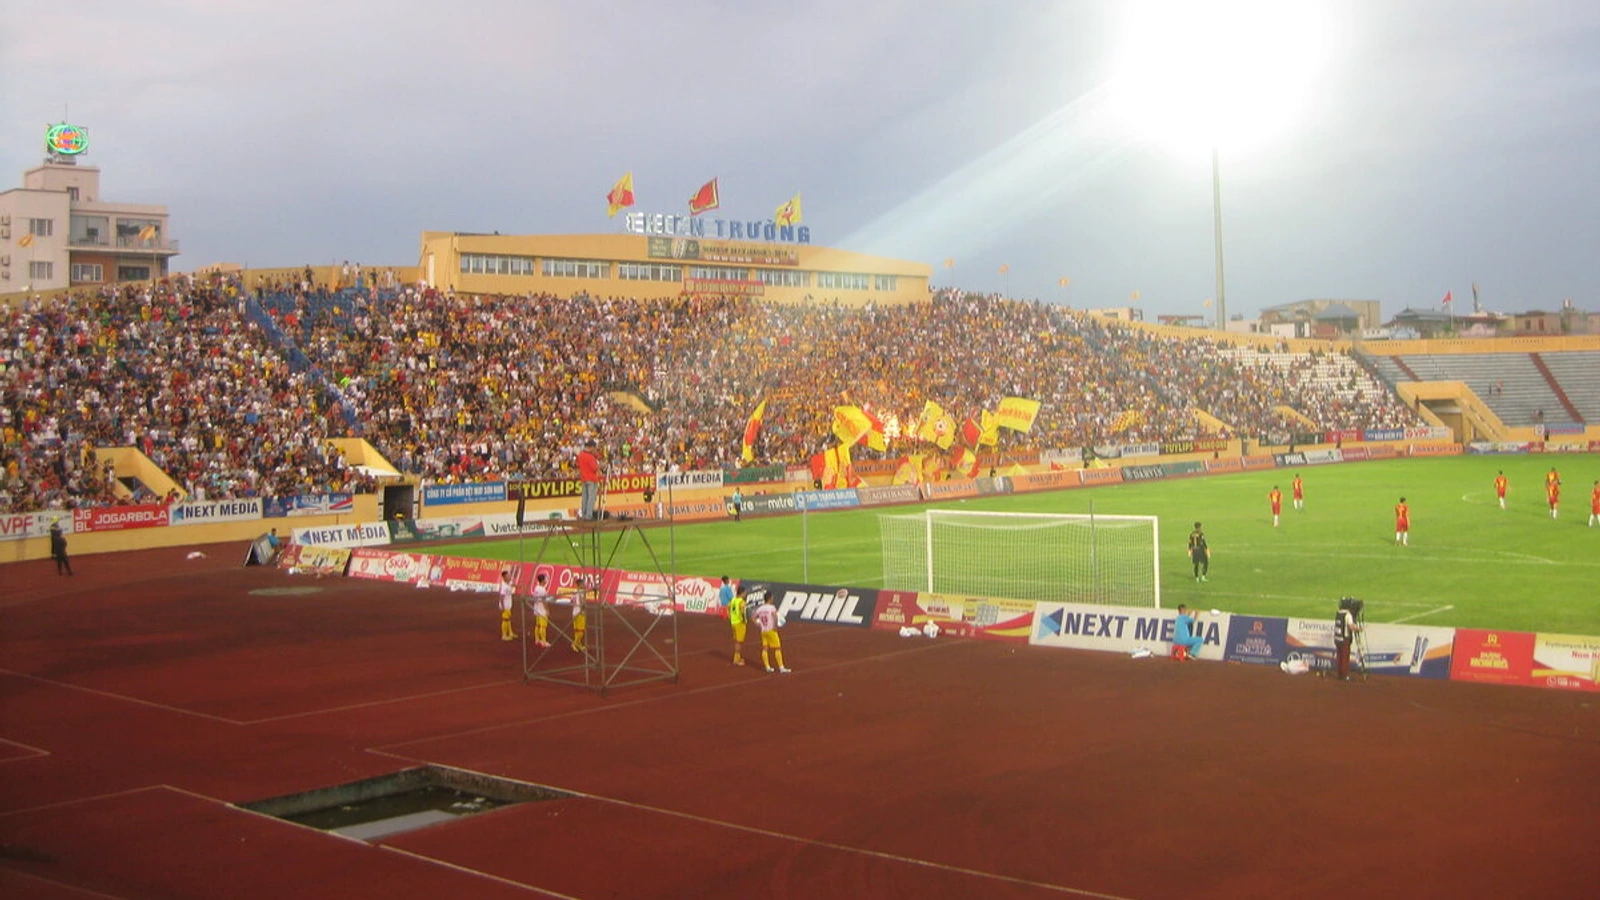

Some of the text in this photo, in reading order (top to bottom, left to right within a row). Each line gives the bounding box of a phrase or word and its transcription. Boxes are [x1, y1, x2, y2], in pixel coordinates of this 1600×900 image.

[522, 480, 583, 498] TUYLIPS
[631, 475, 656, 491] ONE
[185, 501, 259, 519] NEXT MEDIA
[767, 495, 794, 510] mitre
[1, 515, 34, 536] VPF
[94, 509, 168, 525] JOGARBOLA
[311, 524, 387, 545] NEXT MEDIA
[1064, 612, 1130, 639] NEXT
